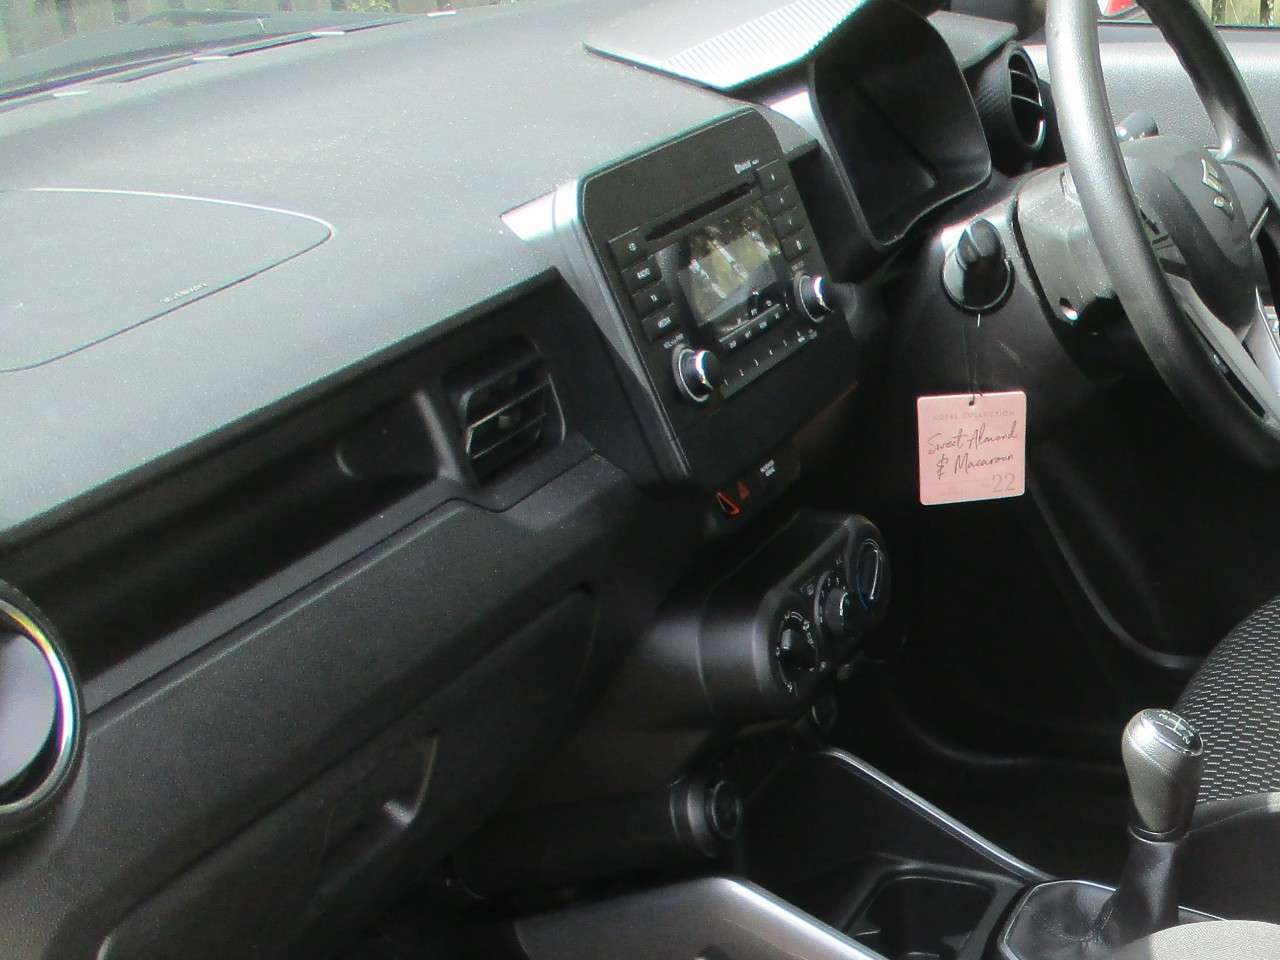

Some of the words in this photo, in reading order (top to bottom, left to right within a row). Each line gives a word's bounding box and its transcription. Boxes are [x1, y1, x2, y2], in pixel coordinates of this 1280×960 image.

[928, 428, 966, 455] Sweet
[966, 420, 1018, 450] Almond
[992, 473, 1016, 493] 22
